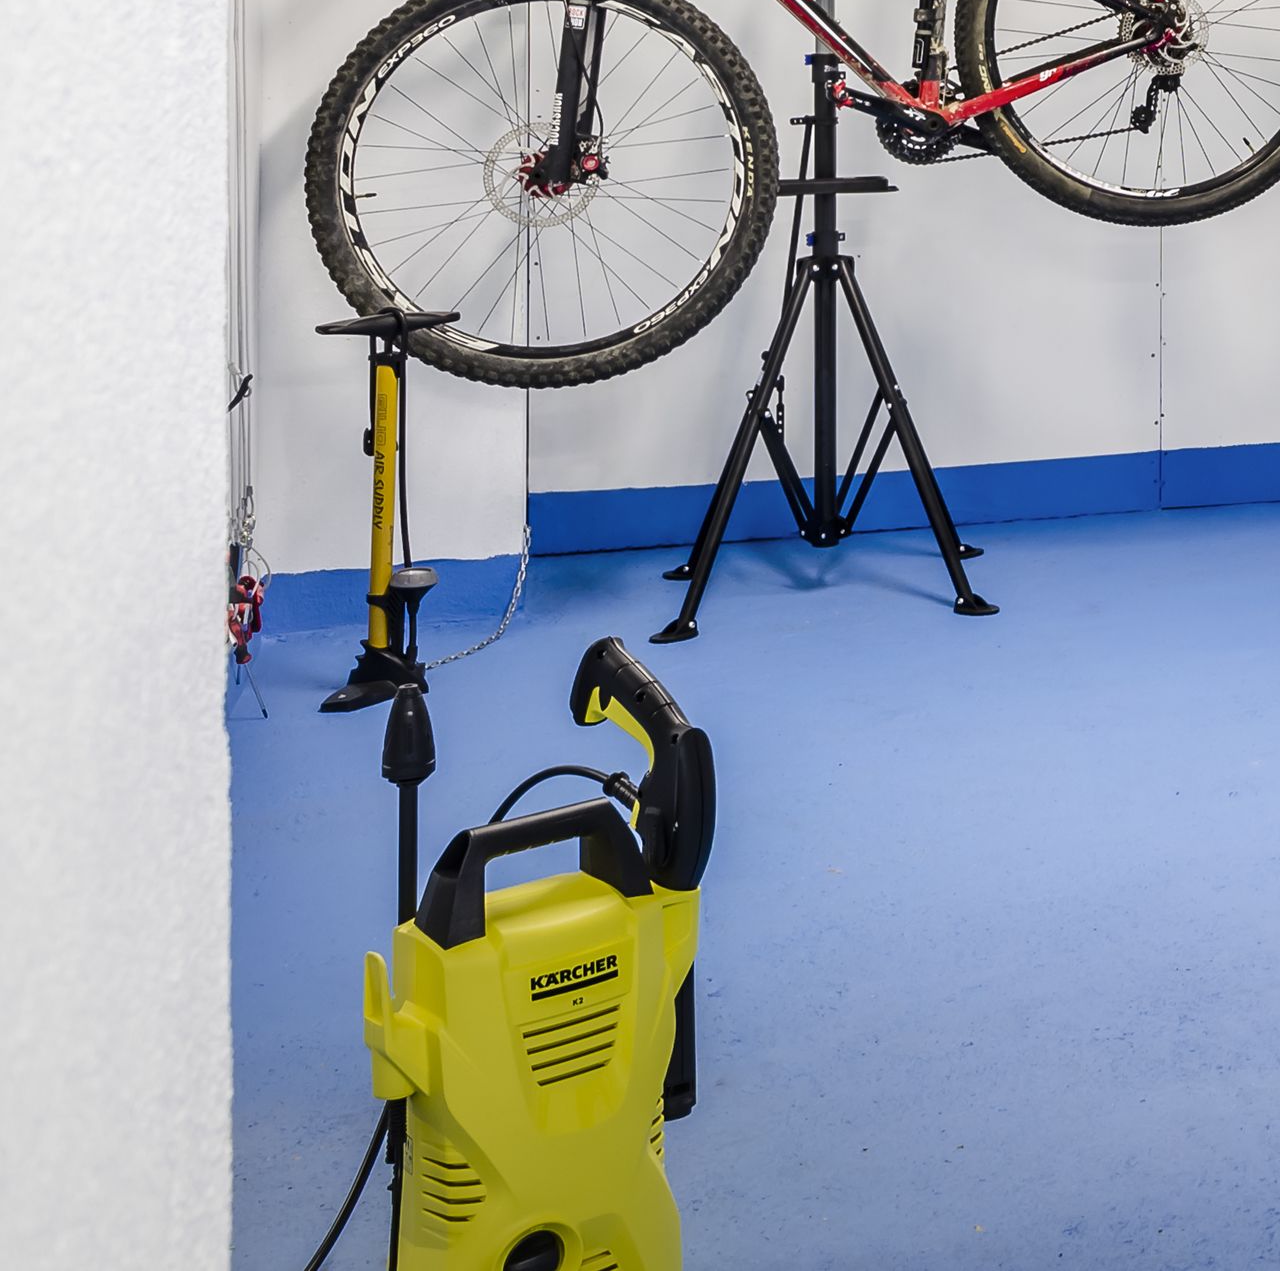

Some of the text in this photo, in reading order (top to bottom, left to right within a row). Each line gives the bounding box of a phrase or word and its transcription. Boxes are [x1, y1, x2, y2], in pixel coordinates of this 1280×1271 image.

[741, 126, 754, 198] KENDA
[530, 954, 618, 991] KÄRCHER
[572, 997, 584, 1006] K2
